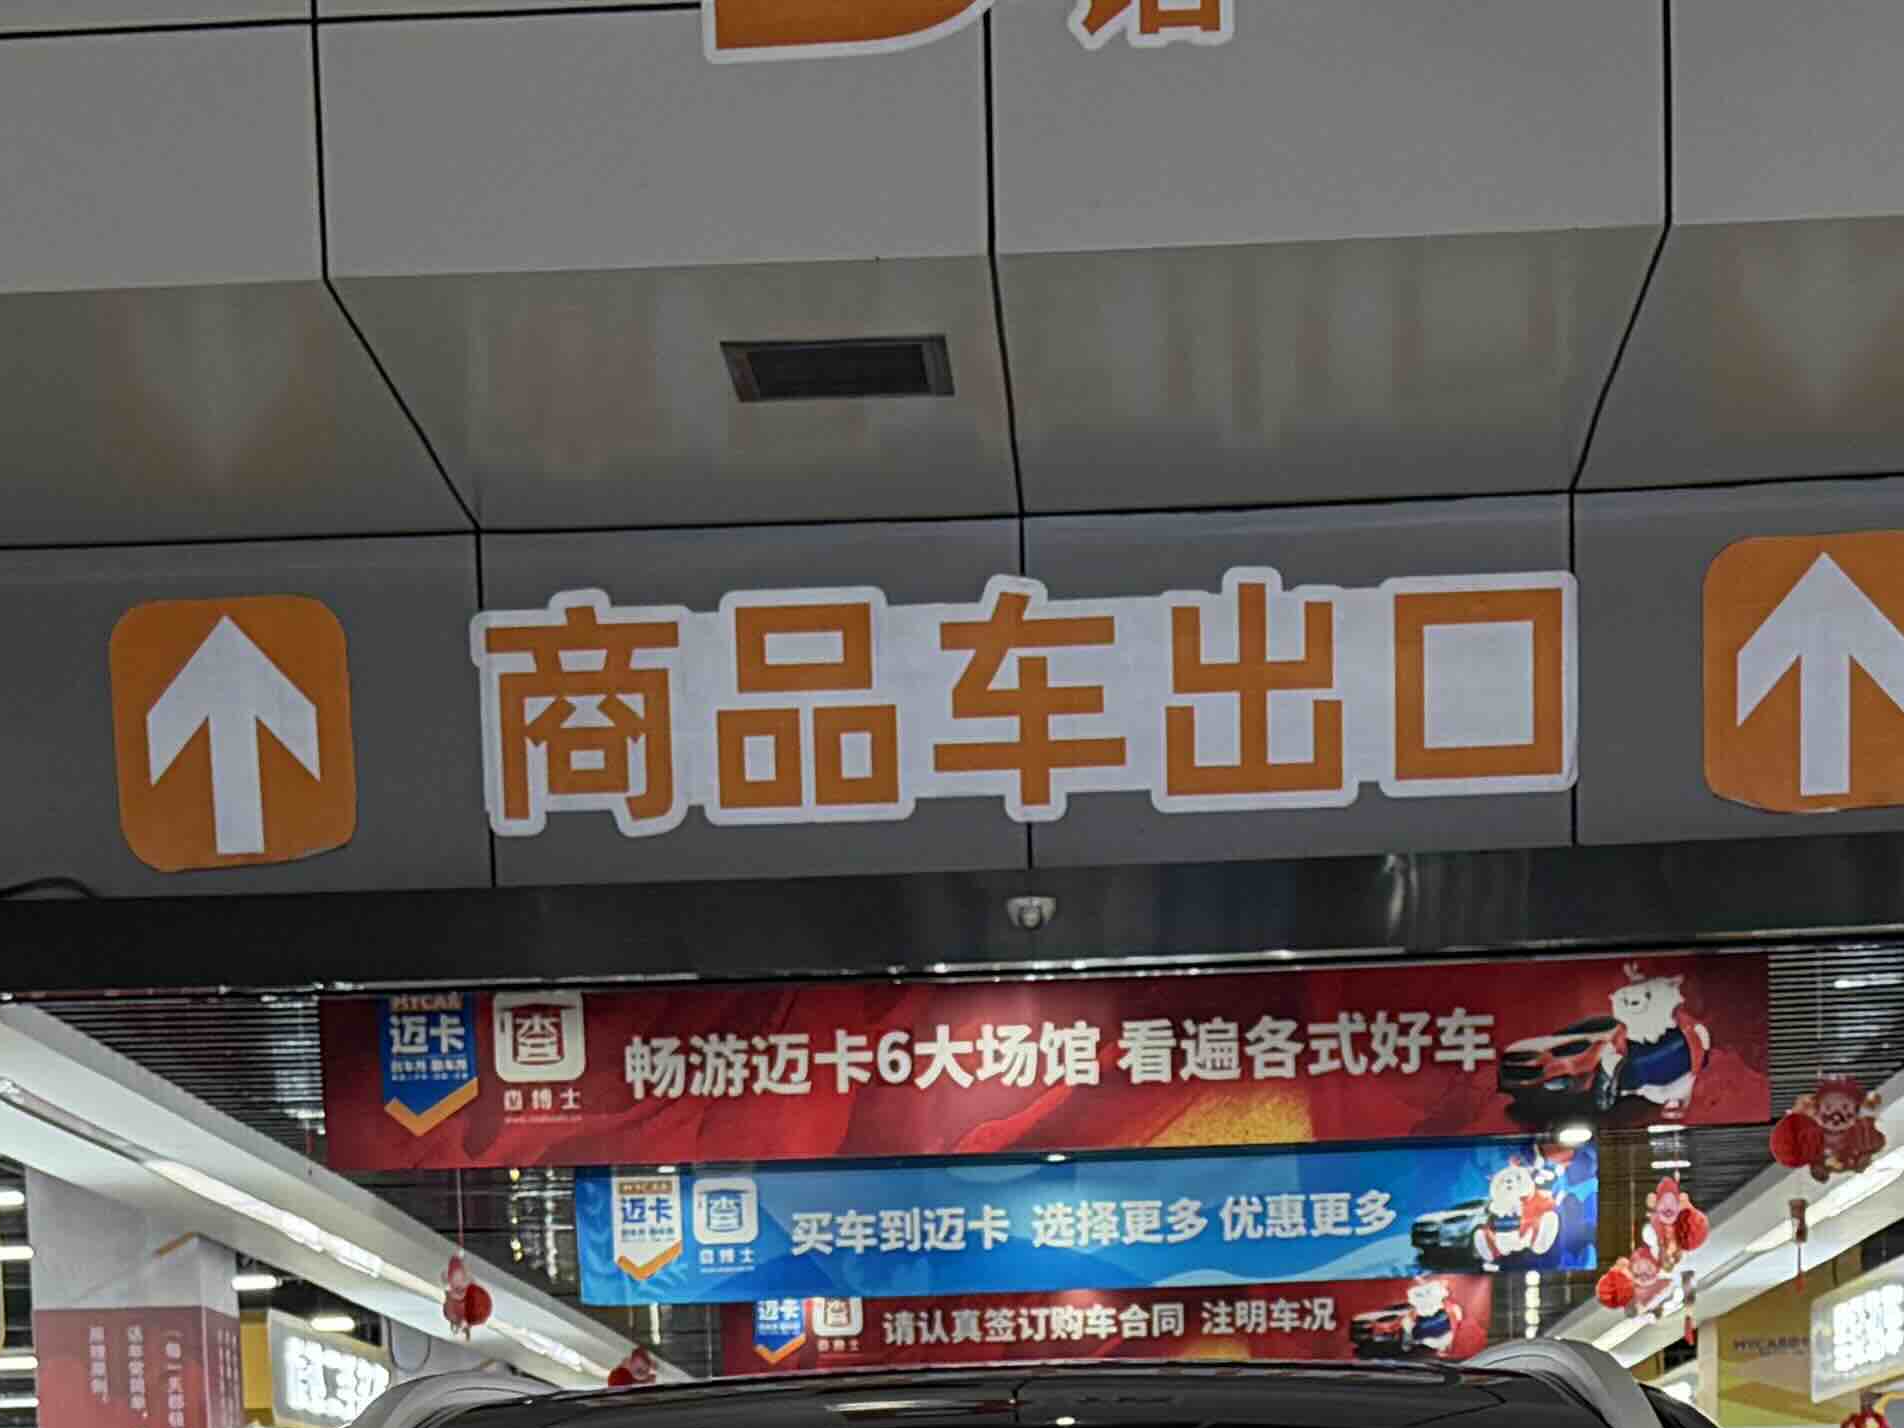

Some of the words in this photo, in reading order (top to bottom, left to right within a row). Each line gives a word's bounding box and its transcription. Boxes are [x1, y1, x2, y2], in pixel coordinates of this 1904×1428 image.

[479, 577, 1571, 828] 商品车出口
[389, 1014, 465, 1054] 迈卡
[623, 1020, 1100, 1101] 畅游迈卡6大场馆
[1117, 1006, 1496, 1084] 看遍各式好车
[620, 1197, 674, 1223] 迈卡
[791, 1206, 1010, 1257] 买车到迈卡
[1032, 1198, 1208, 1249] 选择更多
[1220, 1188, 1397, 1243] 优惠更多
[882, 1303, 1185, 1346] 请认真签订购车合同
[1201, 1298, 1336, 1336] 注明车况
